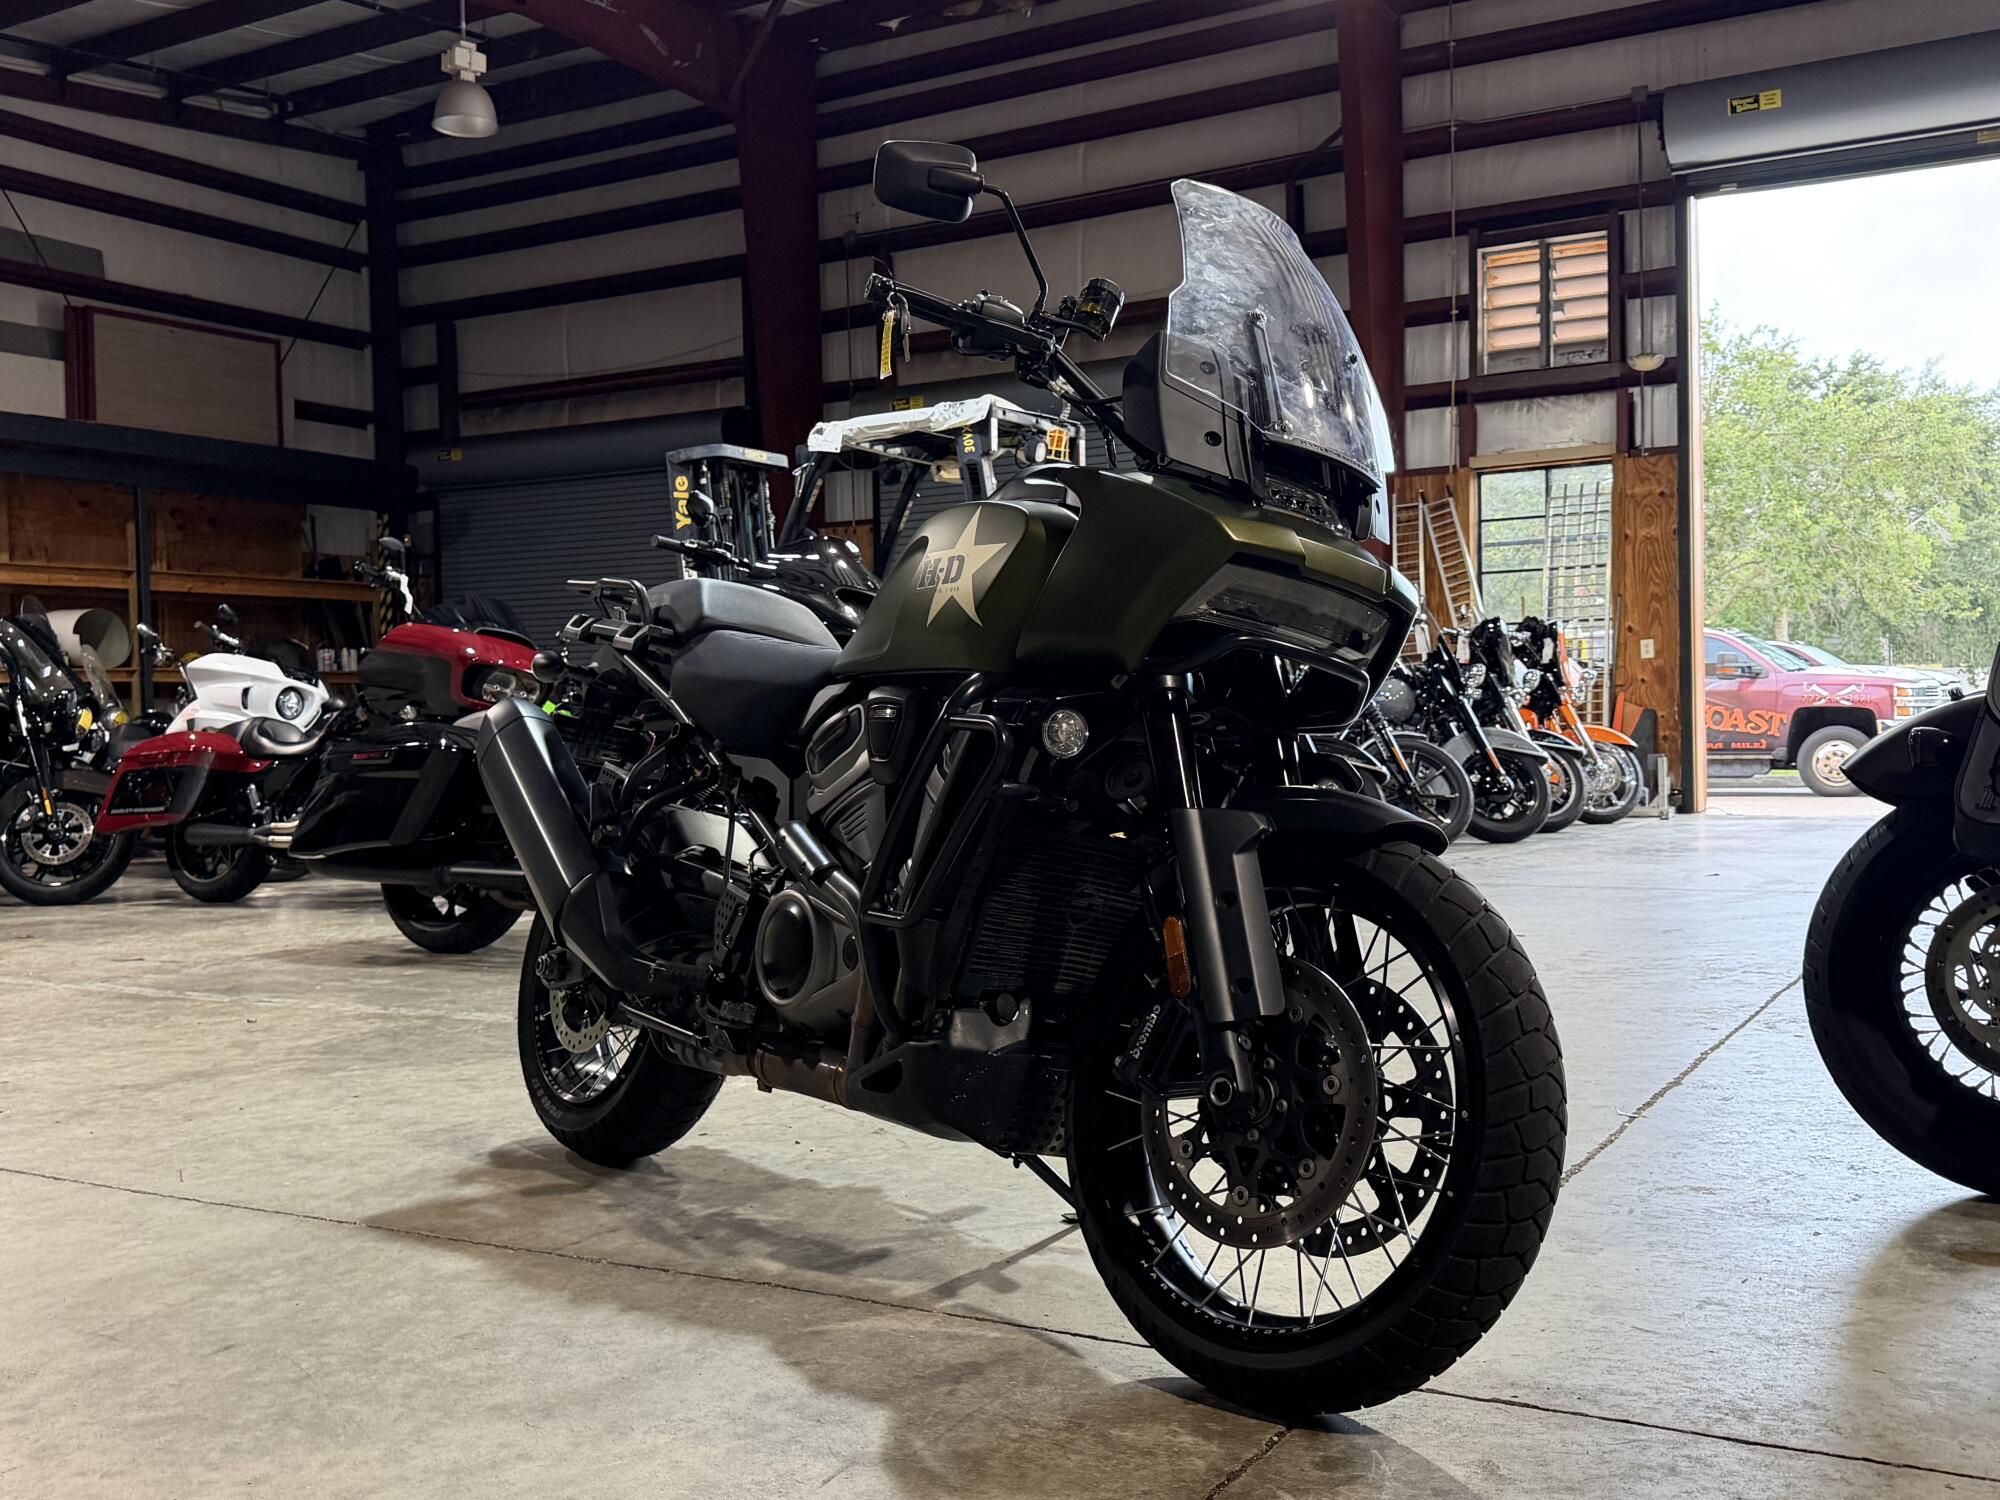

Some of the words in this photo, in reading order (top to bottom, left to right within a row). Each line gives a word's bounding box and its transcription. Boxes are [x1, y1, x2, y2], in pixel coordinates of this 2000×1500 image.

[673, 475, 692, 530] Yale
[916, 554, 966, 590] H-D
[1129, 1004, 1161, 1060] brembo
